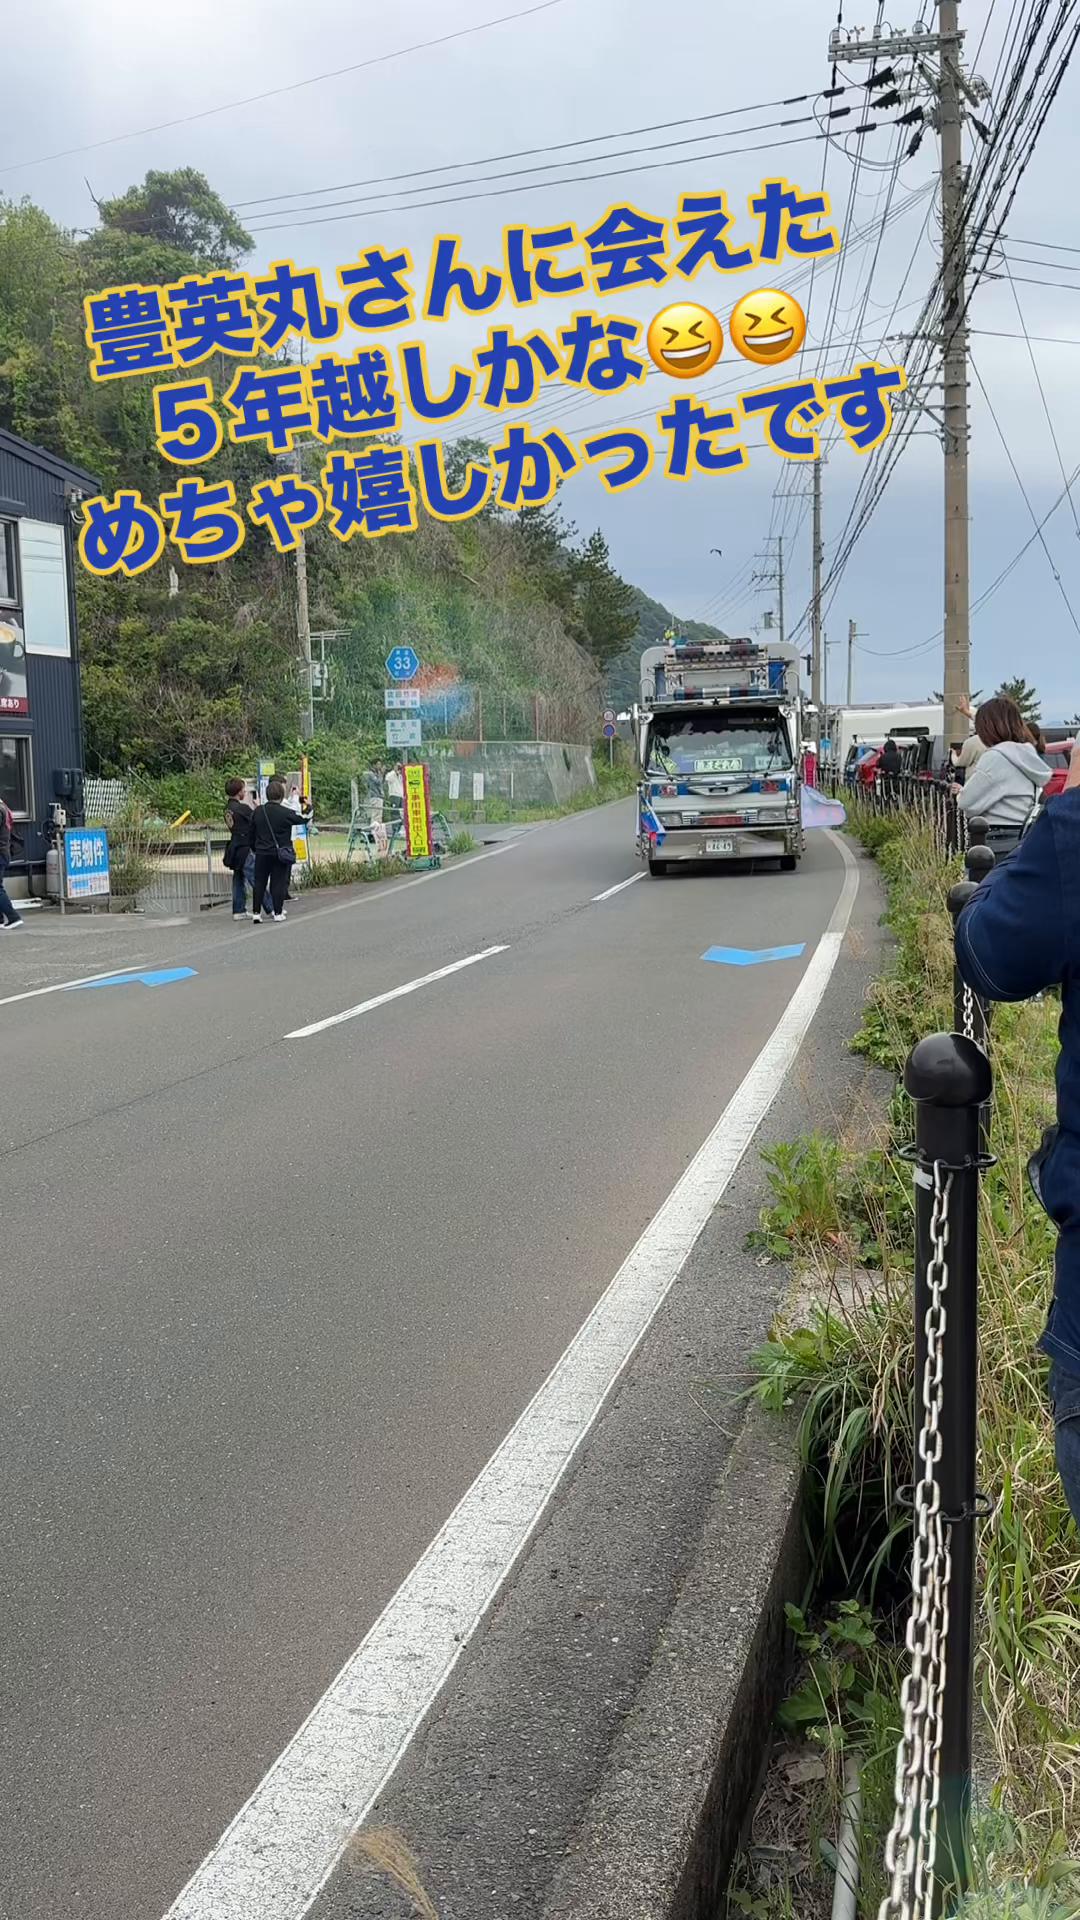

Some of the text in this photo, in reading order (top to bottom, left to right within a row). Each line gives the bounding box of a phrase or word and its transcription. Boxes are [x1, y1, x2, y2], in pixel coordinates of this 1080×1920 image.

[393, 656, 411, 670] 33
[69, 837, 105, 869] 売物件
